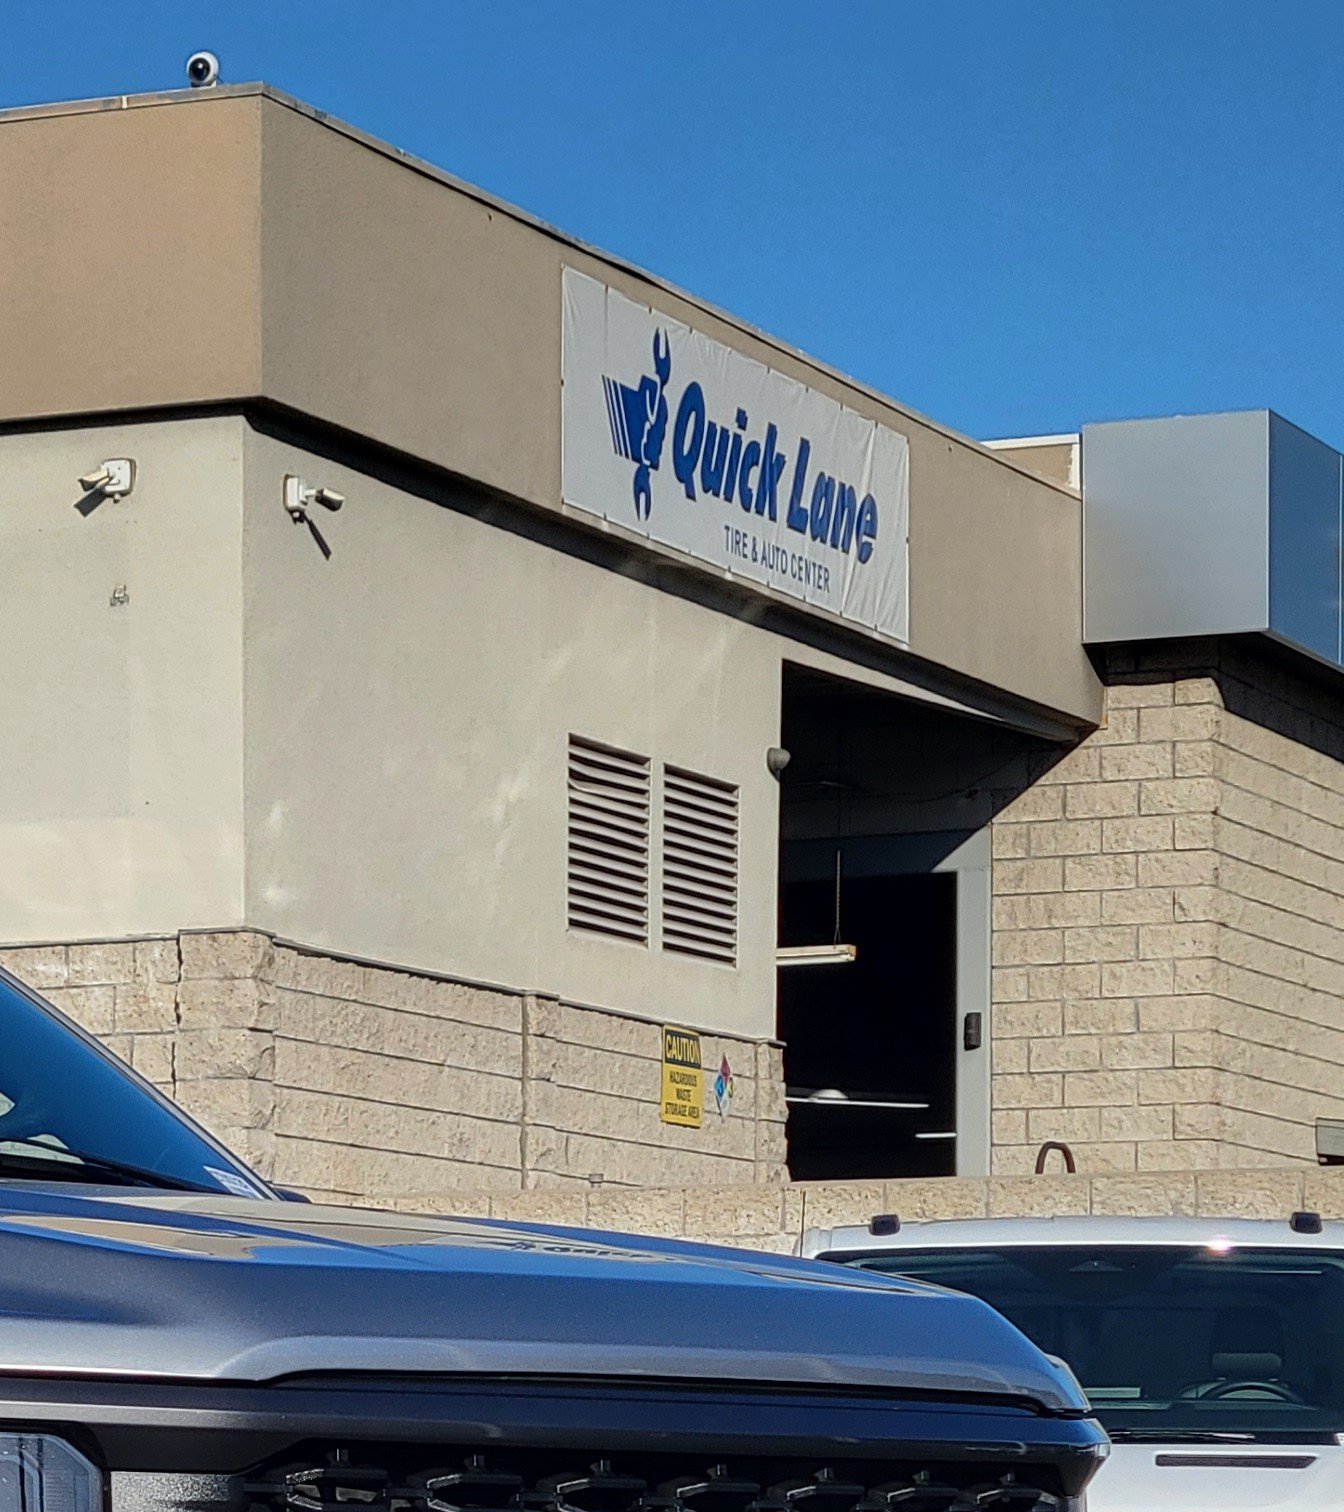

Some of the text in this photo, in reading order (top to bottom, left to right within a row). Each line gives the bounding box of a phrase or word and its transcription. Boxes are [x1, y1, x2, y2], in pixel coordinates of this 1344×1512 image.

[673, 381, 879, 564] Quick Lane
[724, 524, 831, 594] TIRE & AUTO CENTER
[665, 1034, 701, 1064] CAUTION
